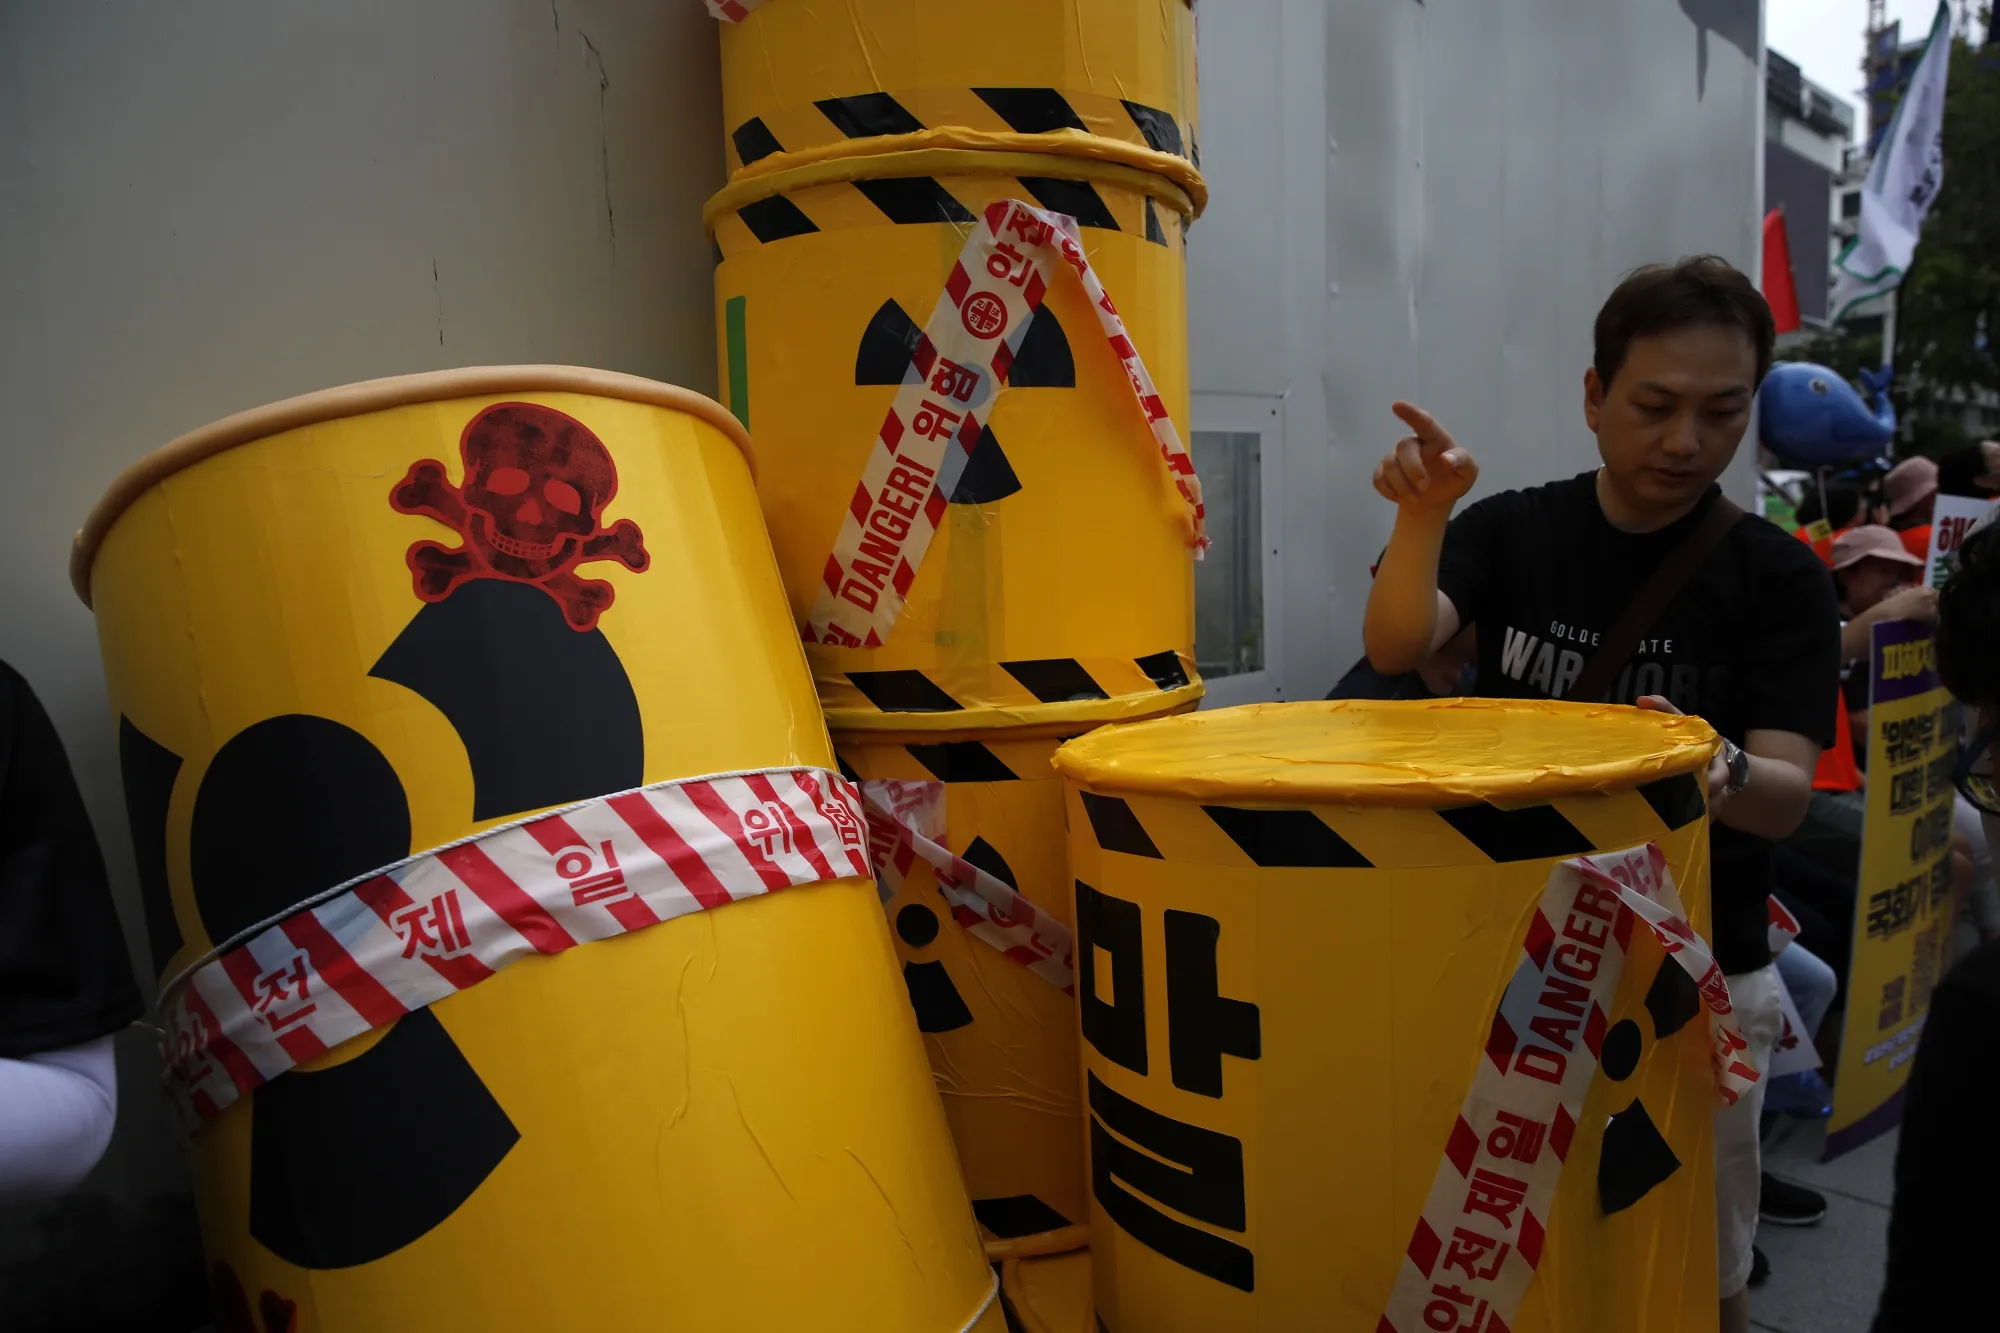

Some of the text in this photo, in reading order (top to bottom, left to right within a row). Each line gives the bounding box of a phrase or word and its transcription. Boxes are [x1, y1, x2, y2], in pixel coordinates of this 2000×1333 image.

[840, 453, 935, 613] DANGER!
[912, 357, 980, 441] 위험
[1550, 620, 1673, 654] GOLDE ATE
